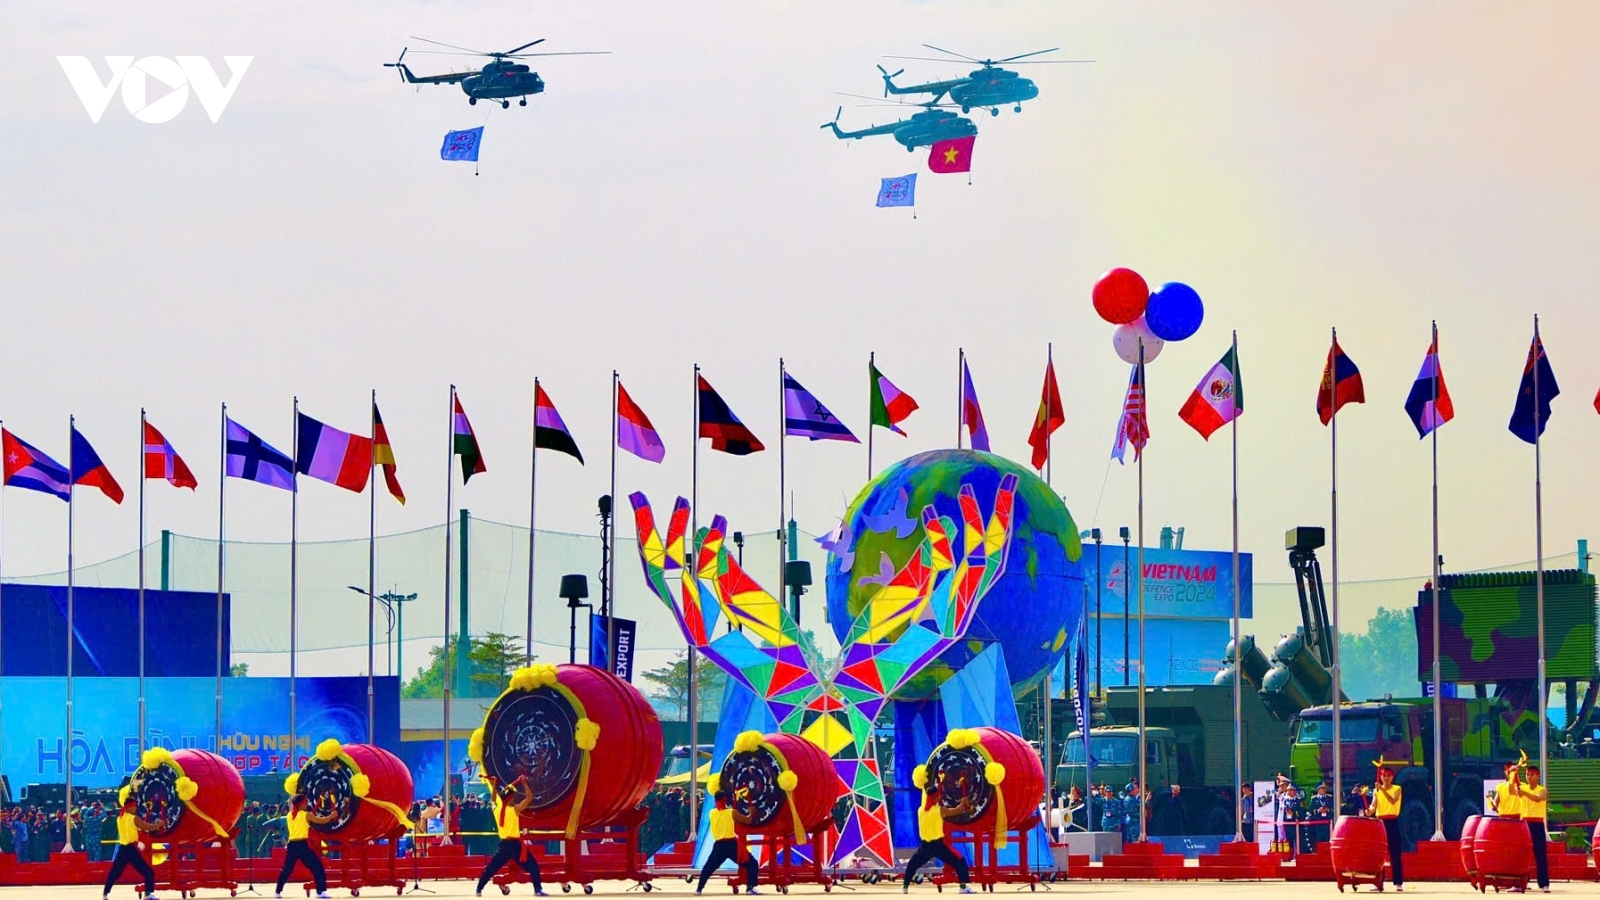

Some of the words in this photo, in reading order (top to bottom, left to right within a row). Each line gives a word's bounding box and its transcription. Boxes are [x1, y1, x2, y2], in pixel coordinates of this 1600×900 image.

[1153, 593, 1174, 602] EXPO
[1175, 584, 1216, 602] 2024
[220, 731, 259, 750] HỮU
[227, 754, 261, 774] ỢP
